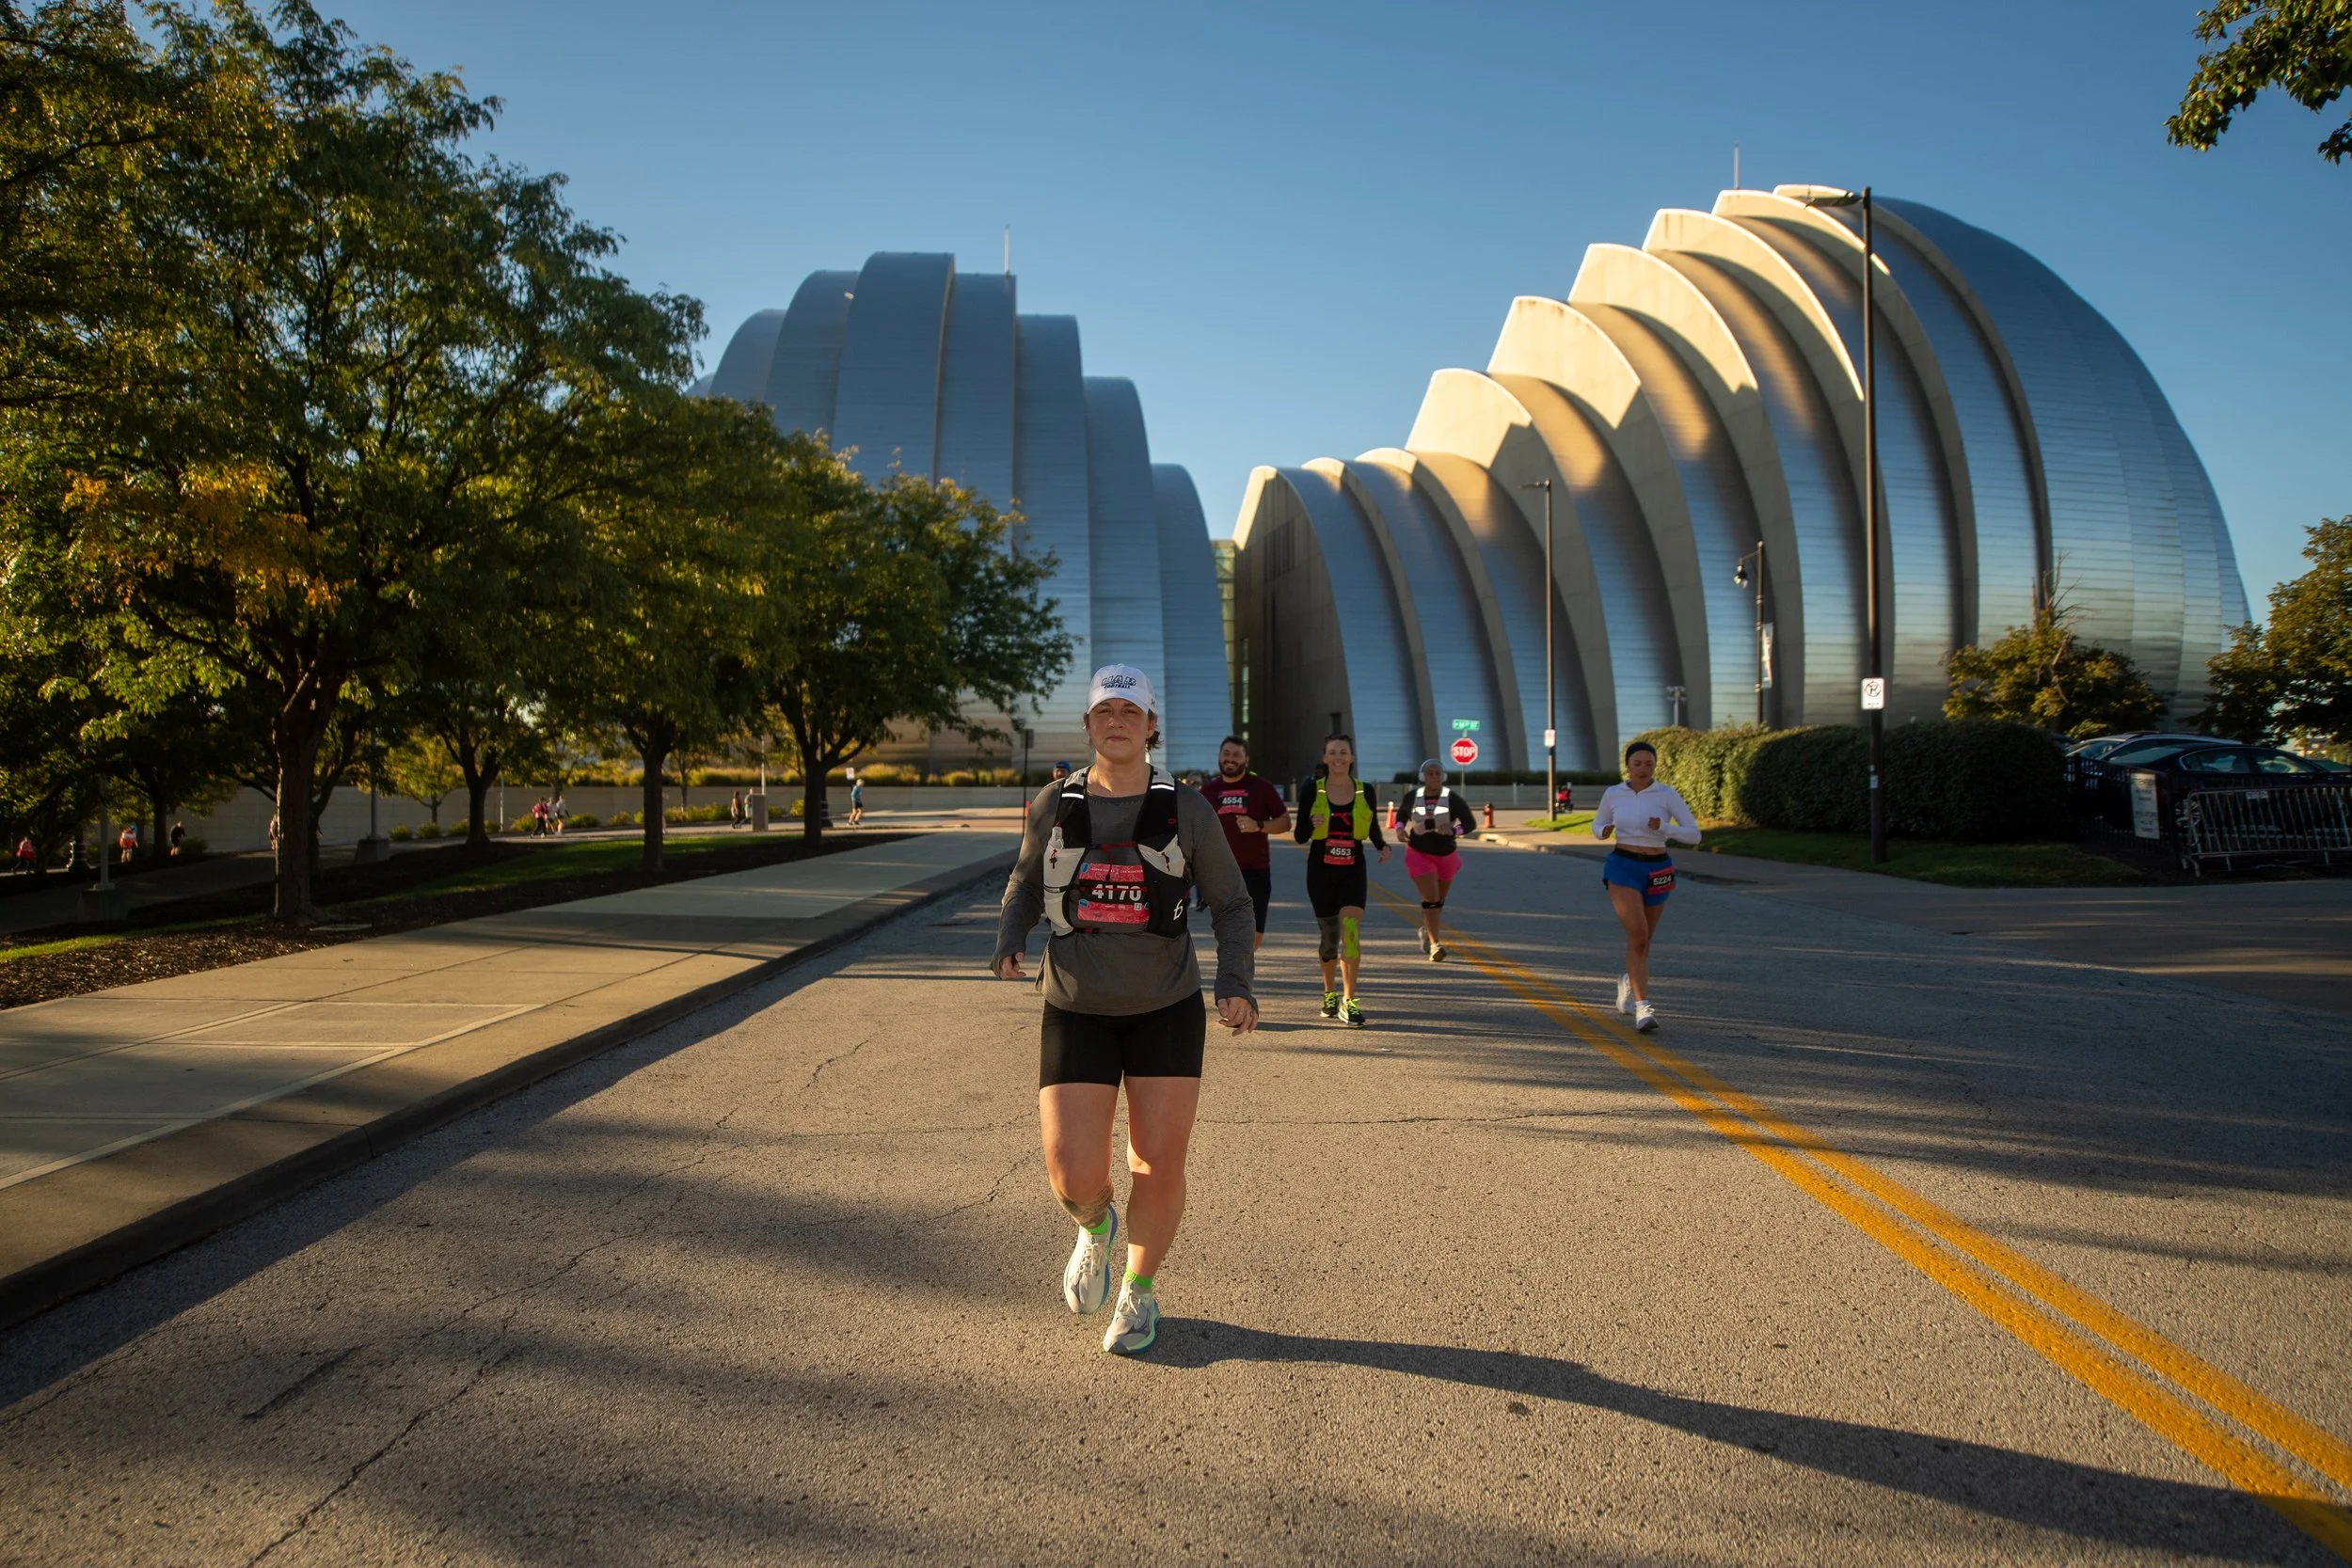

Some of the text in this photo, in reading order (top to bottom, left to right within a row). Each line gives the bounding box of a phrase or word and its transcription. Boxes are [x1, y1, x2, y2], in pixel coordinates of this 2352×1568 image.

[1101, 675, 1136, 687] UAB
[1453, 746, 1475, 757] STOP
[1222, 796, 1242, 804] 4554
[1330, 847, 1352, 856] 4553
[1091, 883, 1142, 901] 4170
